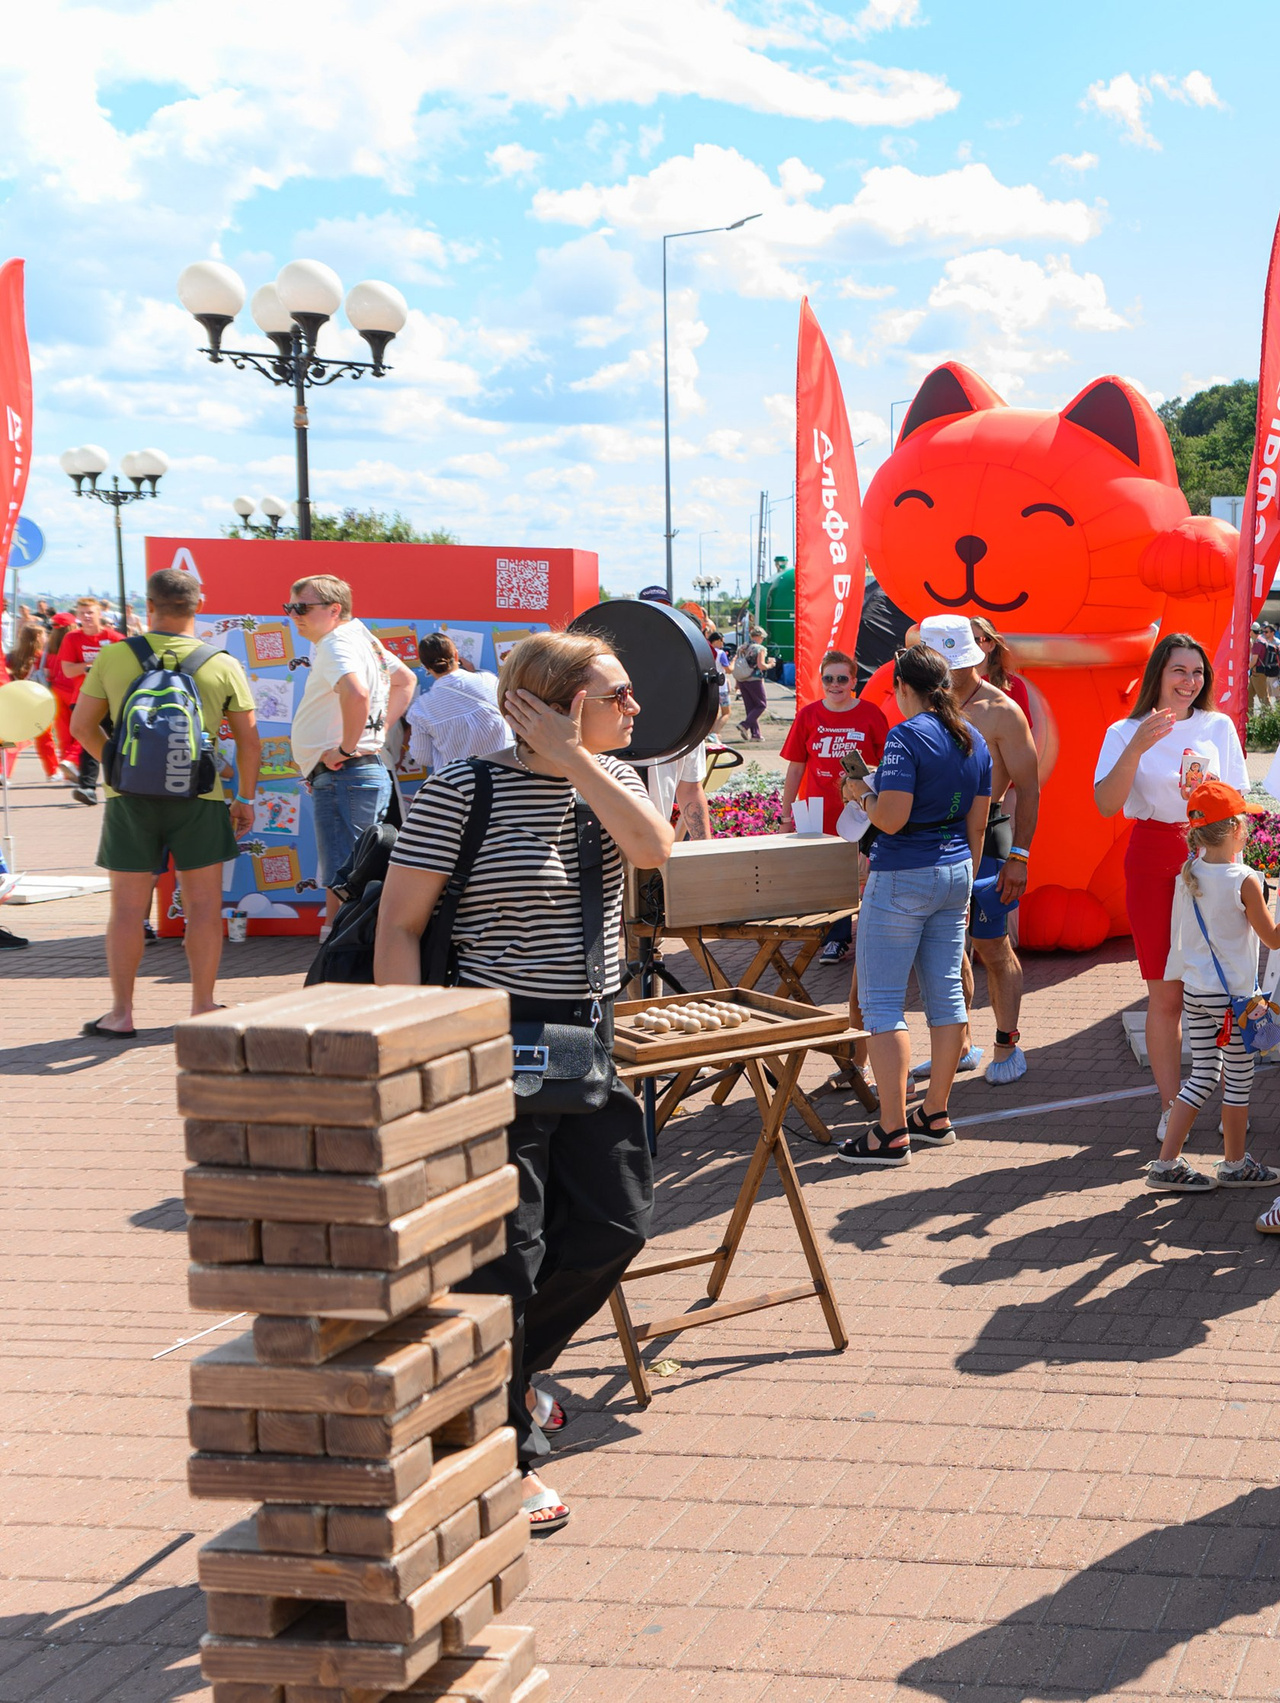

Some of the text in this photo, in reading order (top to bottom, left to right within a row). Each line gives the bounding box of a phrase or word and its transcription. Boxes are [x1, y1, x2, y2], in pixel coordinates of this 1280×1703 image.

[813, 428, 849, 566] Альфа
[165, 714, 192, 794] arena
[832, 742, 857, 750] OPEN
